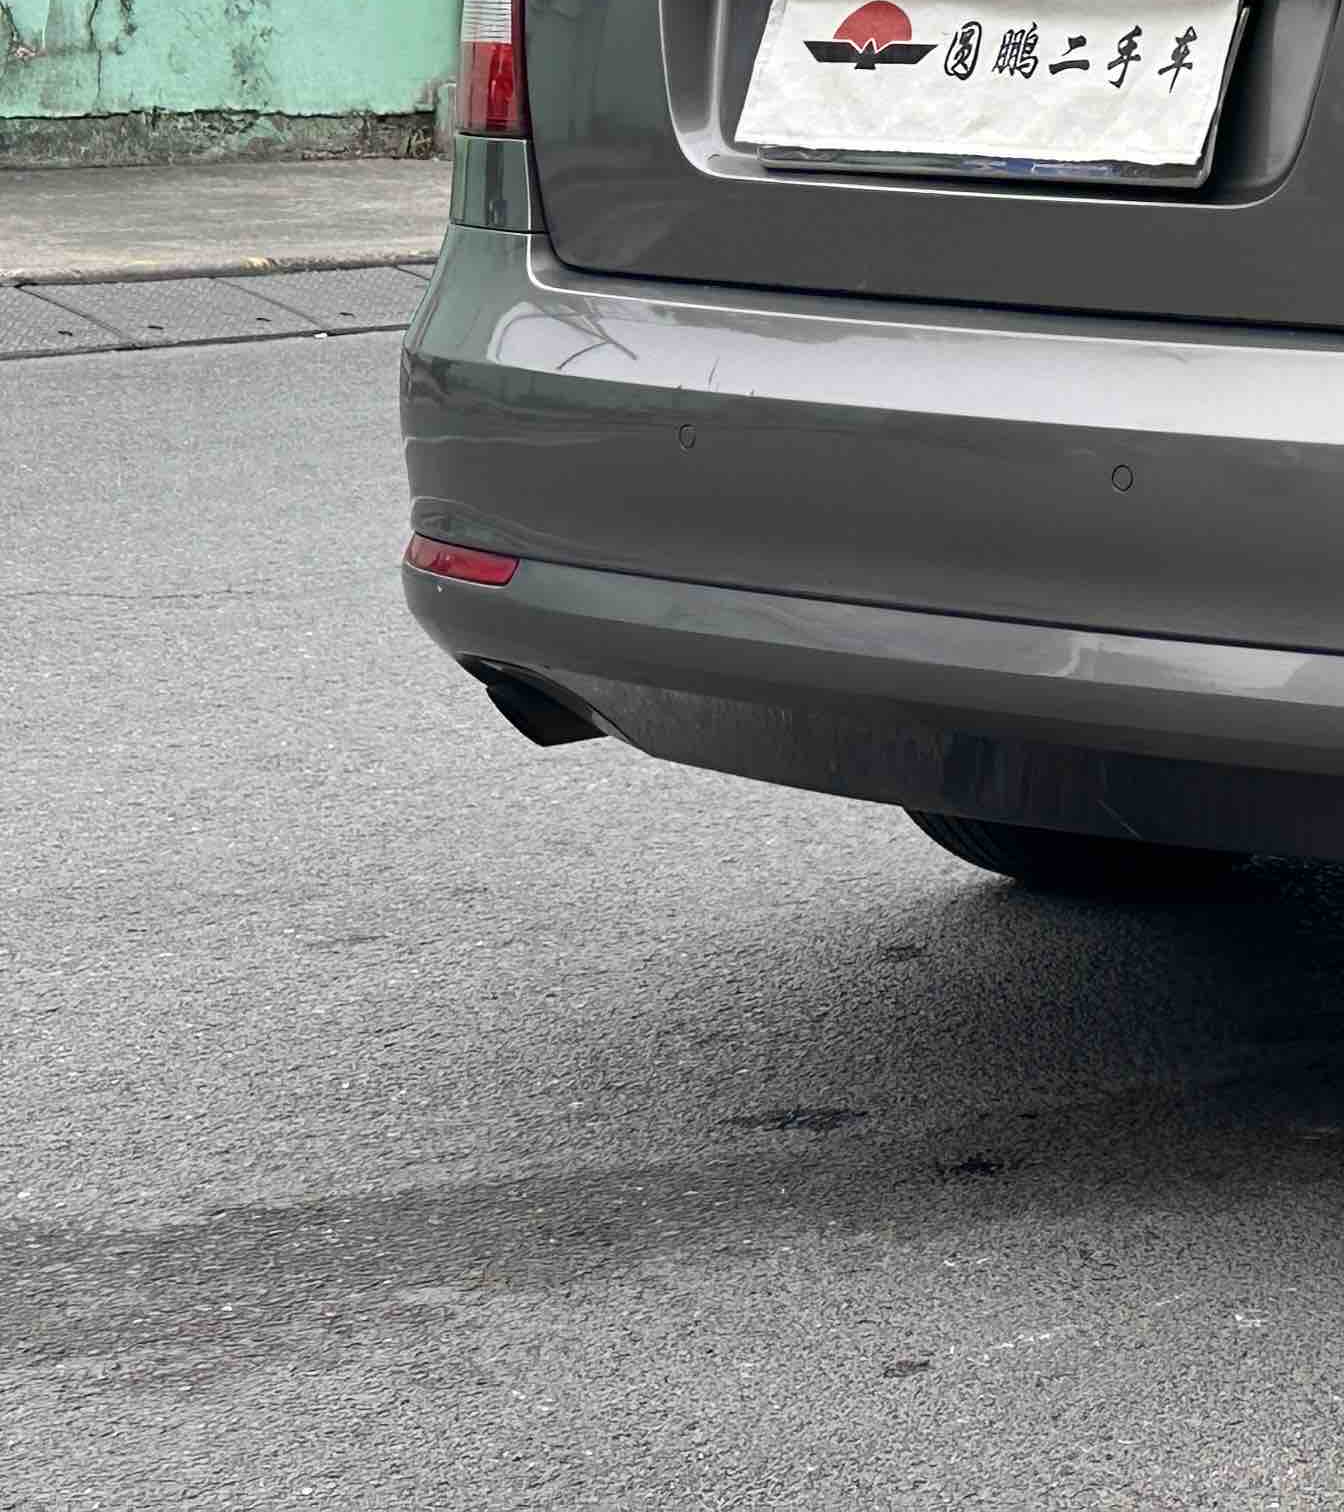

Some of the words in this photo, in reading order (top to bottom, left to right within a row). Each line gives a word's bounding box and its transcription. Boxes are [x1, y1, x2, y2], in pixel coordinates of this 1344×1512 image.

[944, 20, 1199, 94] 圆鹏二手车
